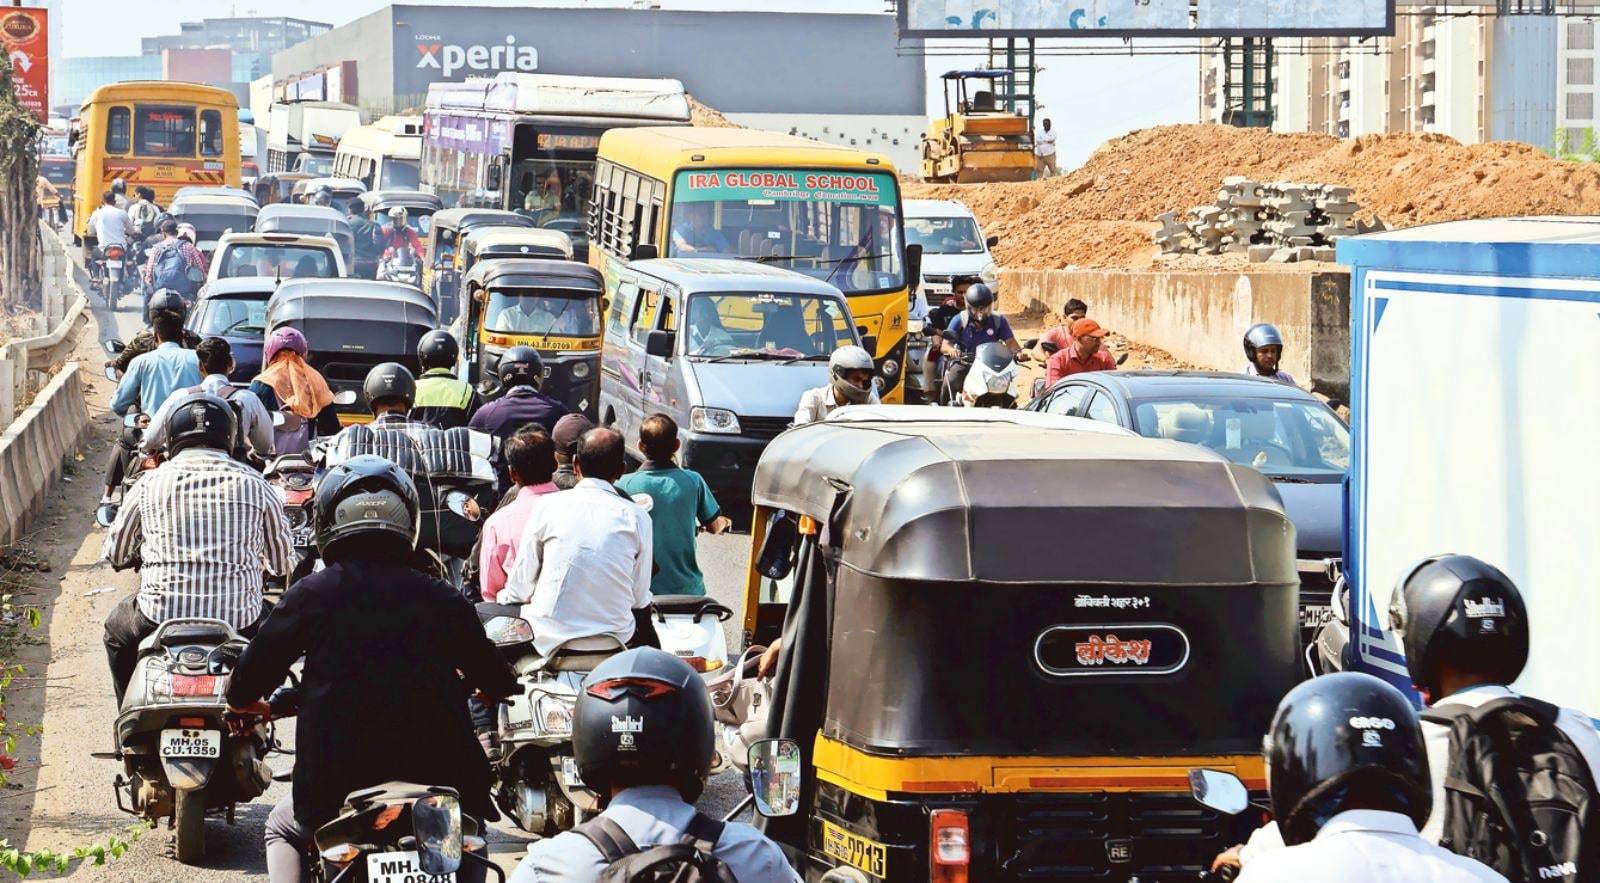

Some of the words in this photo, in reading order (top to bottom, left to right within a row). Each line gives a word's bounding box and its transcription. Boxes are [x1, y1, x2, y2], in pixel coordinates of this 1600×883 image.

[416, 34, 539, 77] xperia
[688, 173, 721, 189] IRA
[724, 173, 799, 189] GLOBAL
[805, 175, 879, 192] SCHOOL
[1075, 634, 1152, 666] लोकेश
[170, 738, 209, 747] MH.05
[162, 746, 217, 756] CU.1359
[1111, 847, 1128, 858] RE
